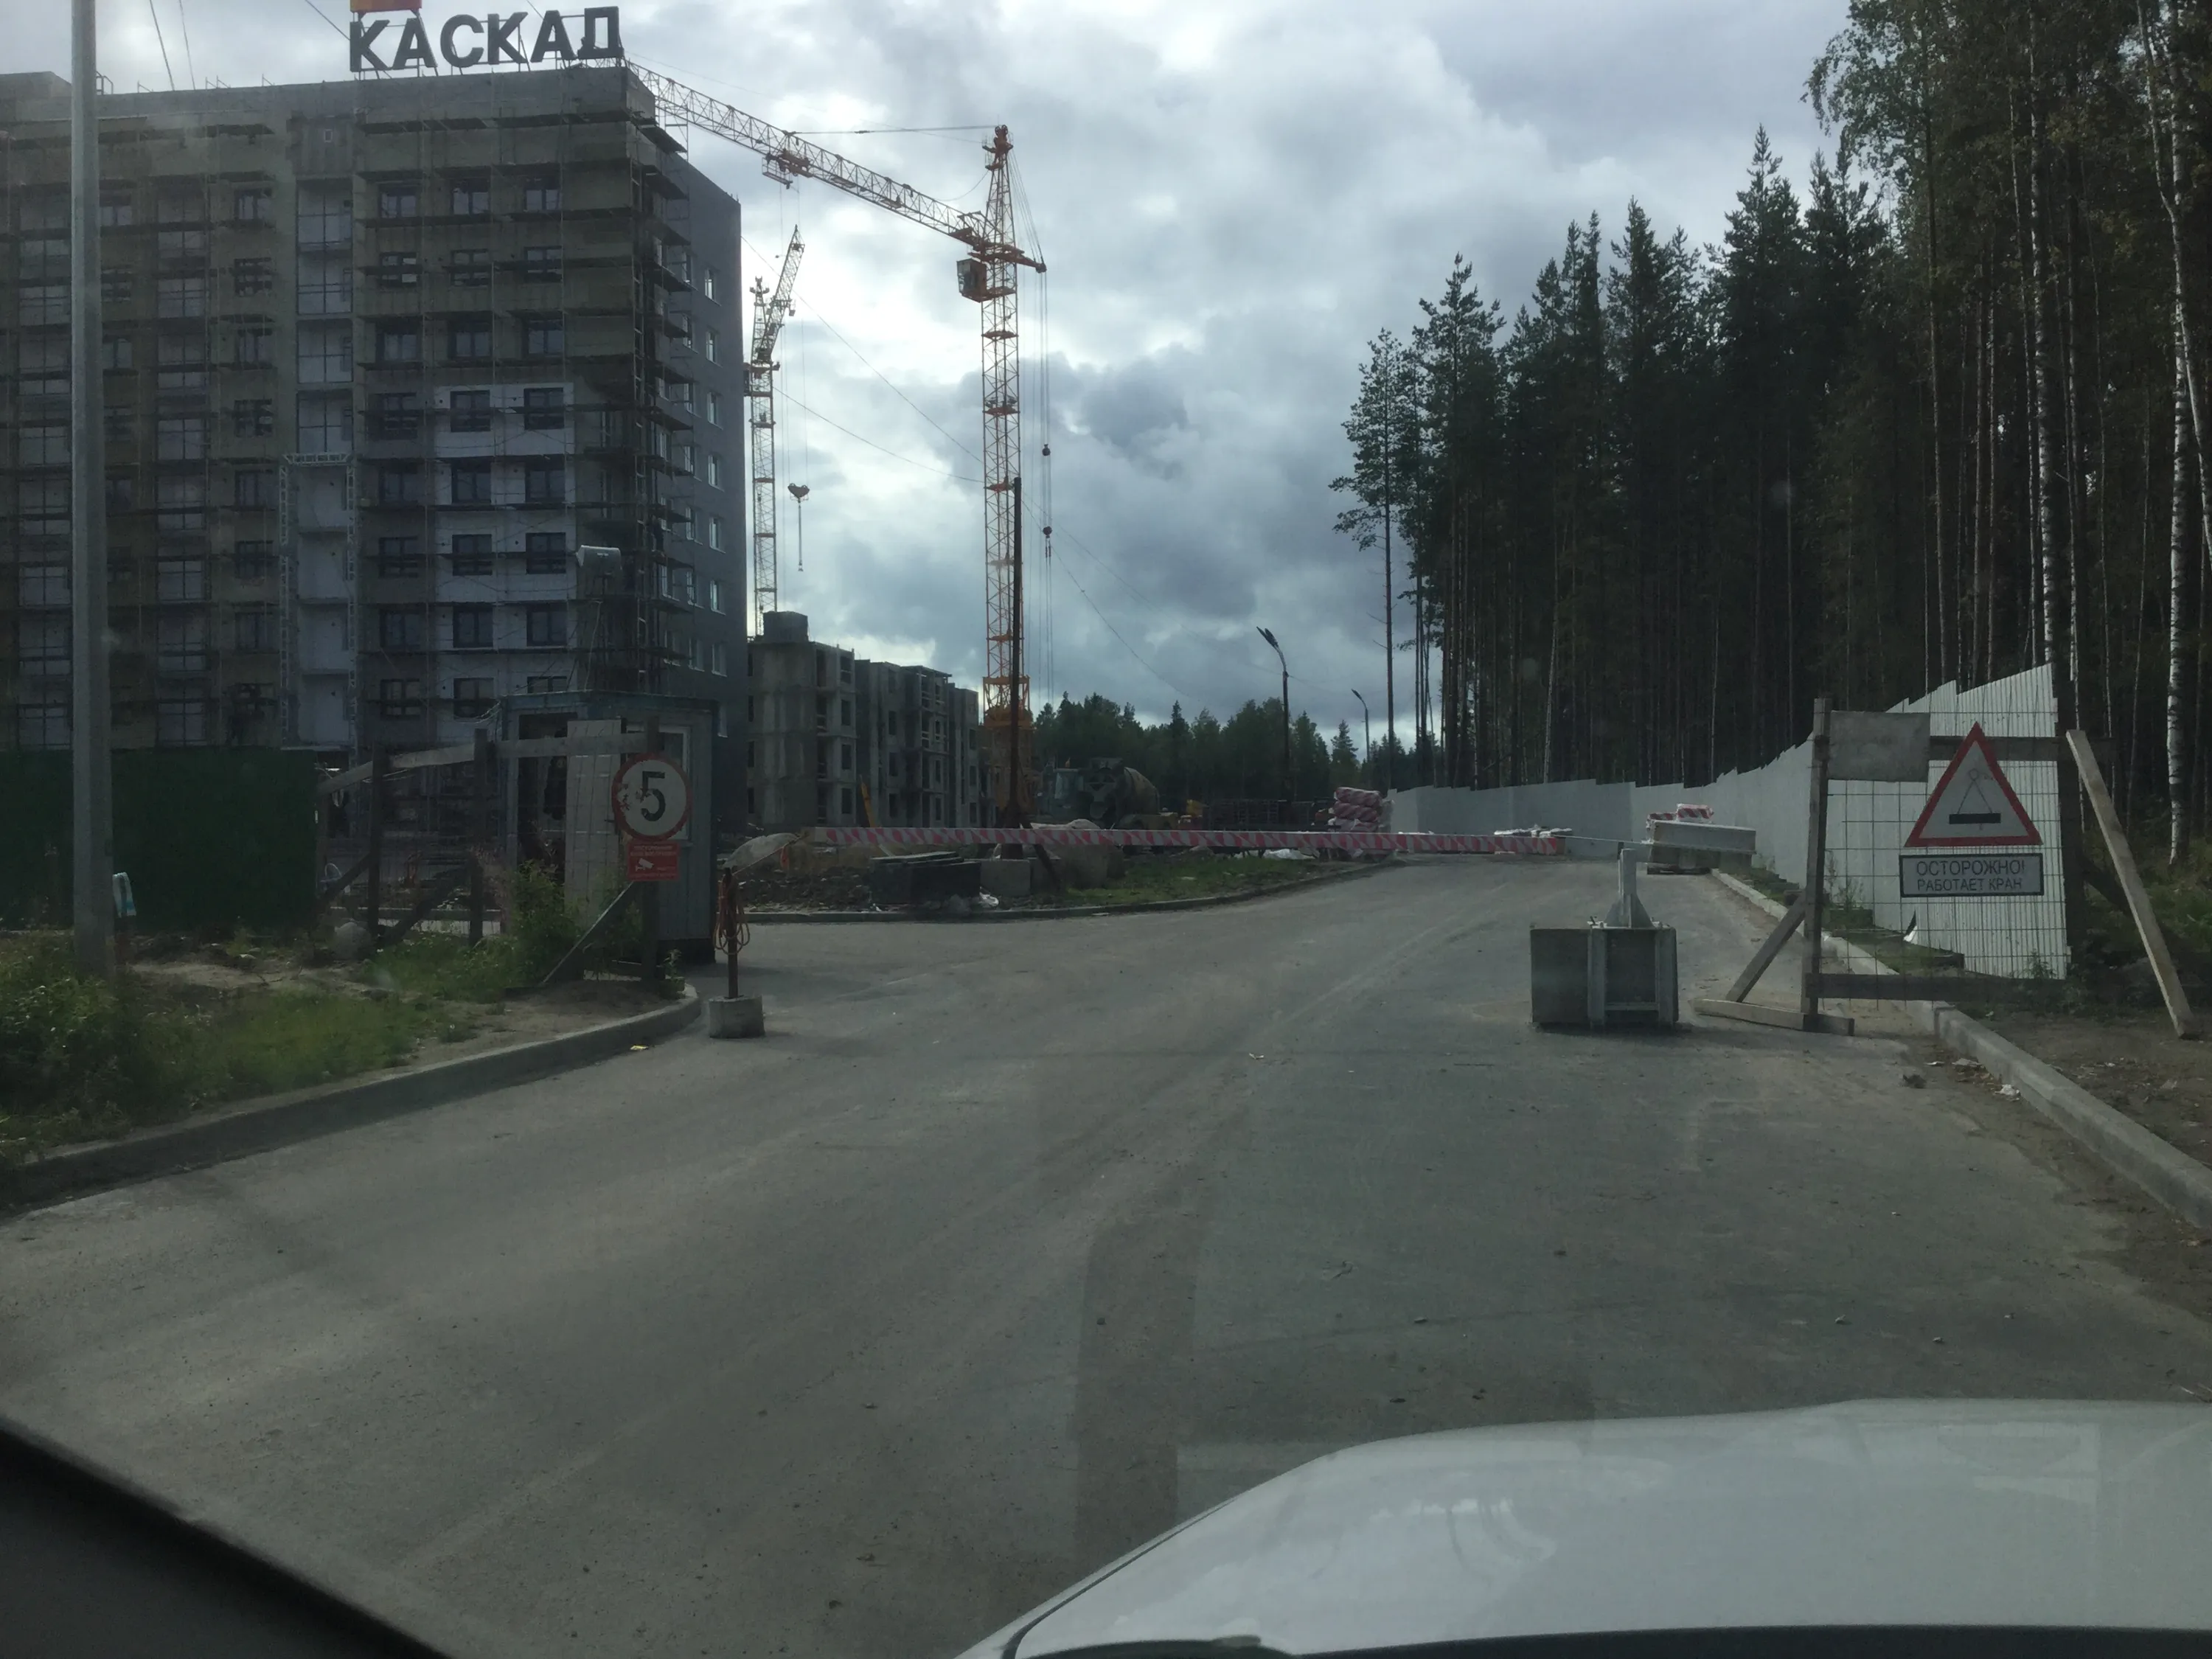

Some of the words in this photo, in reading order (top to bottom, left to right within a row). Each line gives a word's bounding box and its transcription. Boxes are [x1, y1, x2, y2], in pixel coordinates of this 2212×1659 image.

[349, 6, 625, 72] КАСКАД
[641, 771, 666, 821] 5
[1916, 860, 2025, 876] ОСТОРОЖНО!
[1917, 878, 1984, 891] РАБОТАЕТ
[1989, 877, 2023, 891] КРАН
